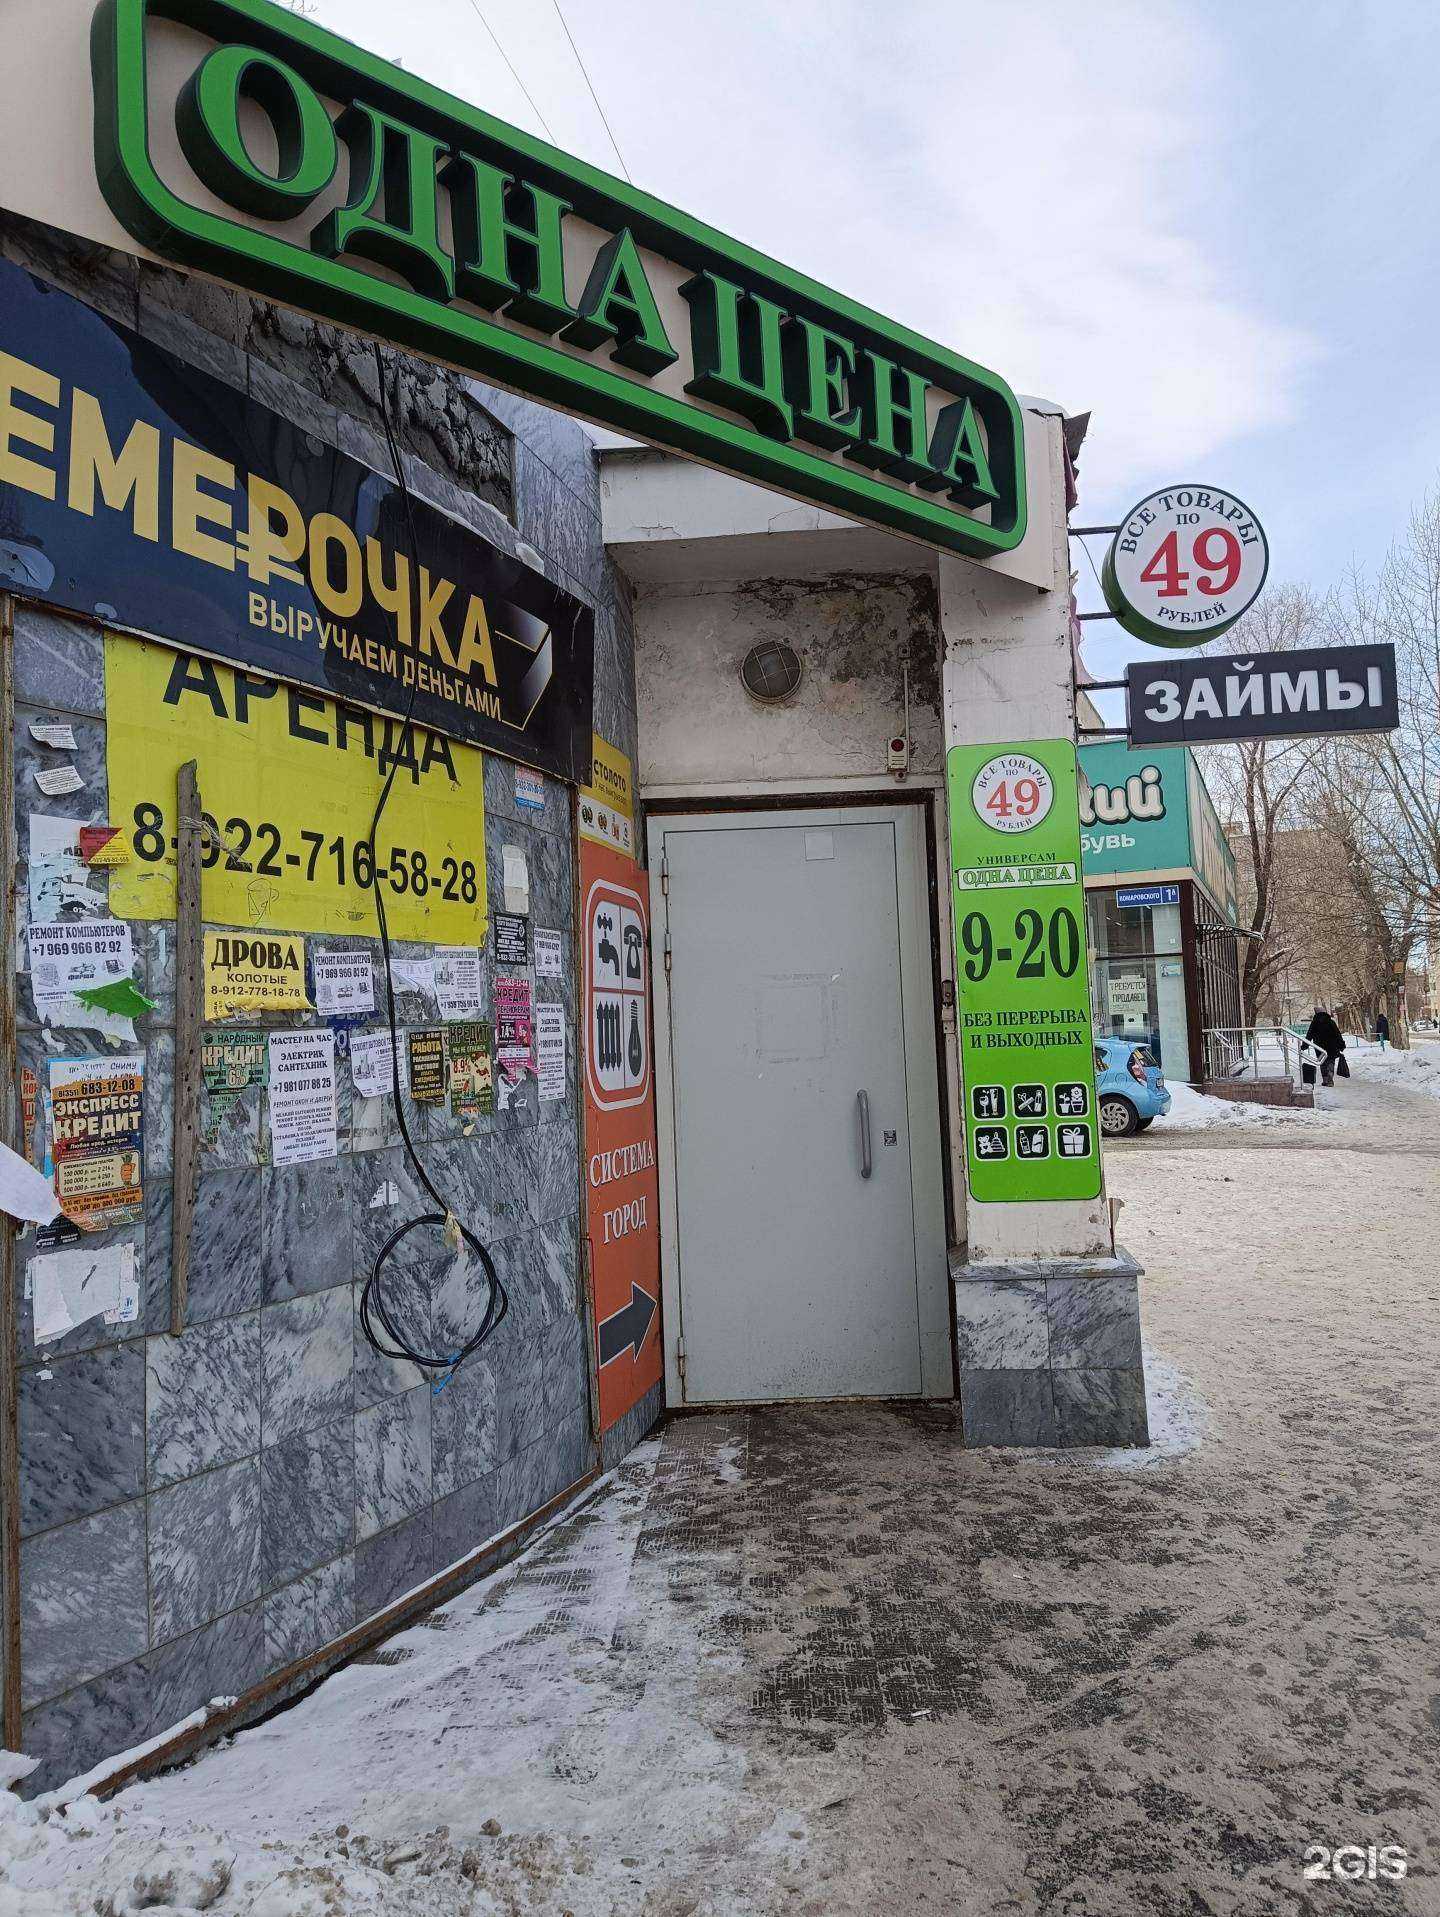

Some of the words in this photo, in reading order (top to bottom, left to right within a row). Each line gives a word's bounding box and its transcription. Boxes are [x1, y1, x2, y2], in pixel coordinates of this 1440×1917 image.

[185, 43, 678, 368] ОДНА
[690, 268, 1000, 502] ЦЕНА
[1120, 507, 1157, 554] ВСЕ
[1158, 491, 1259, 547] ТОВАРЫ
[1176, 512, 1200, 526] ПО
[1140, 527, 1242, 598] 49
[1157, 601, 1227, 624] РУБЛЕЙ
[249, 591, 397, 678] ВЫРУЧАЕМ
[402, 655, 502, 721] ДЕНЬГАМИ
[1144, 660, 1384, 723] ЗАЙМЫ
[163, 654, 457, 785] АРЕНДА
[977, 764, 998, 789] ВСЕ
[999, 758, 1047, 788] ТОВАРЫ
[1005, 768, 1019, 776] ПО
[986, 778, 1041, 817] 49
[976, 852, 1056, 866] УНИВЕРСАМ
[962, 868, 1015, 888] ОДНА
[1017, 865, 1072, 885] ЦЕНА
[29, 926, 64, 939] РЕМОНТ
[66, 924, 126, 939] КОМПЬЮТЕРОВ
[32, 943, 45, 956] +7
[47, 942, 69, 956] 969
[71, 941, 92, 954] 966
[108, 940, 121, 953] 92
[210, 938, 299, 972] ДРОВА
[961, 907, 1080, 982] 9-20
[227, 973, 288, 985] КОЛОТЫЕ
[210, 985, 301, 998] 8-912-778-18-78
[963, 1012, 993, 1028] БЕЗ
[997, 1009, 1088, 1026] ПЕРЕРЫВА
[270, 1036, 303, 1046] МАСТЕР
[303, 1035, 315, 1043] НА
[316, 1034, 332, 1042] ЧАС
[411, 1040, 442, 1054] РАБОТА
[970, 1034, 983, 1049] И
[986, 1030, 1084, 1050] ВЫХОДНЫХ
[201, 1045, 265, 1069] КРЕДИТ
[277, 1060, 328, 1072] САНТЕХНИК
[280, 1050, 325, 1061] ЭЛЕКТРИК
[81, 1078, 135, 1096] 683-12-08
[321, 1077, 332, 1089] 25
[54, 1094, 139, 1117] ЭКСПРЕСС
[54, 1111, 142, 1139] КРЕДИТ
[589, 1139, 655, 1188] СИСТЕМА
[602, 1195, 648, 1245] ГОРОД
